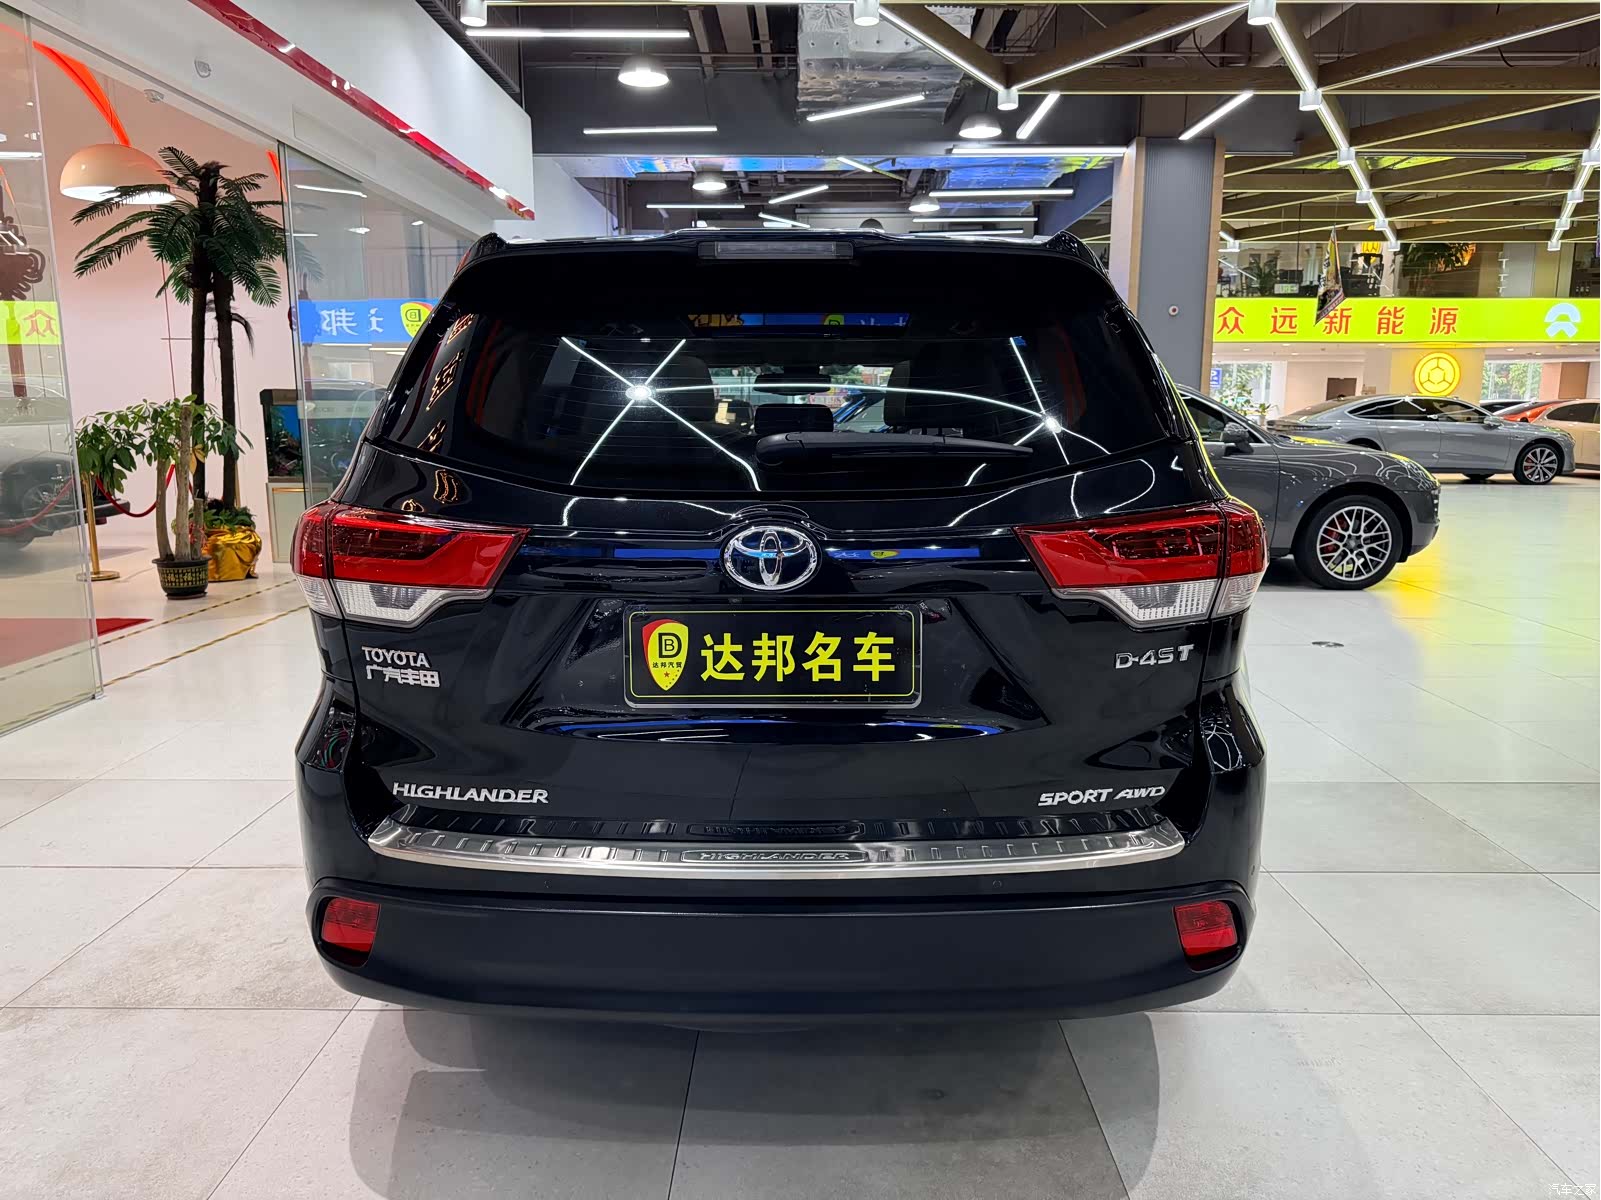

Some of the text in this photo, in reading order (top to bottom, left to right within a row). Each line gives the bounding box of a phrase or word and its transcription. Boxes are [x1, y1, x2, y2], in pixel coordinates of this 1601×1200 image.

[1217, 306, 1459, 335] 众远新能源
[361, 645, 430, 668] TOYOTA
[700, 631, 896, 682] 达邦名车
[365, 664, 440, 687] 广汽丰田
[392, 782, 549, 804] HIGHLANDER
[1037, 786, 1166, 807] SPORT AWD
[700, 852, 850, 860] HIGHLANDER
